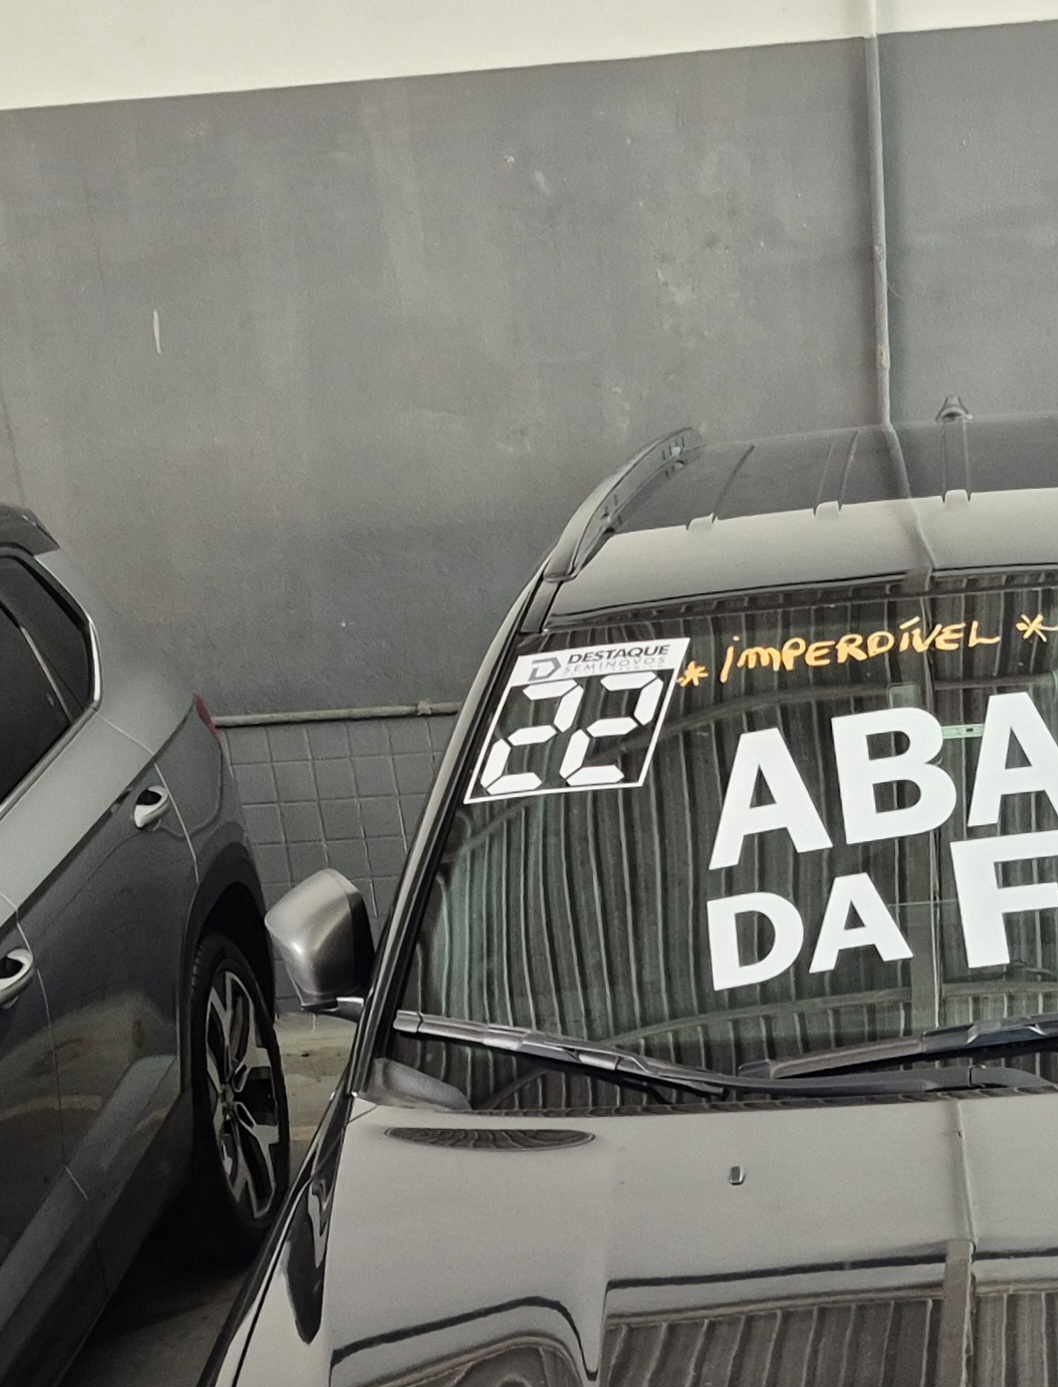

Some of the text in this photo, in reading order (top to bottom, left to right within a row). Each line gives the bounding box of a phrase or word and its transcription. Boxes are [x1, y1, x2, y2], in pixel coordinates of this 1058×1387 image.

[564, 656, 667, 674] SEMINOVOS
[567, 644, 671, 665] DESTAQUE
[480, 671, 664, 796] 22
[707, 872, 914, 992] DA
